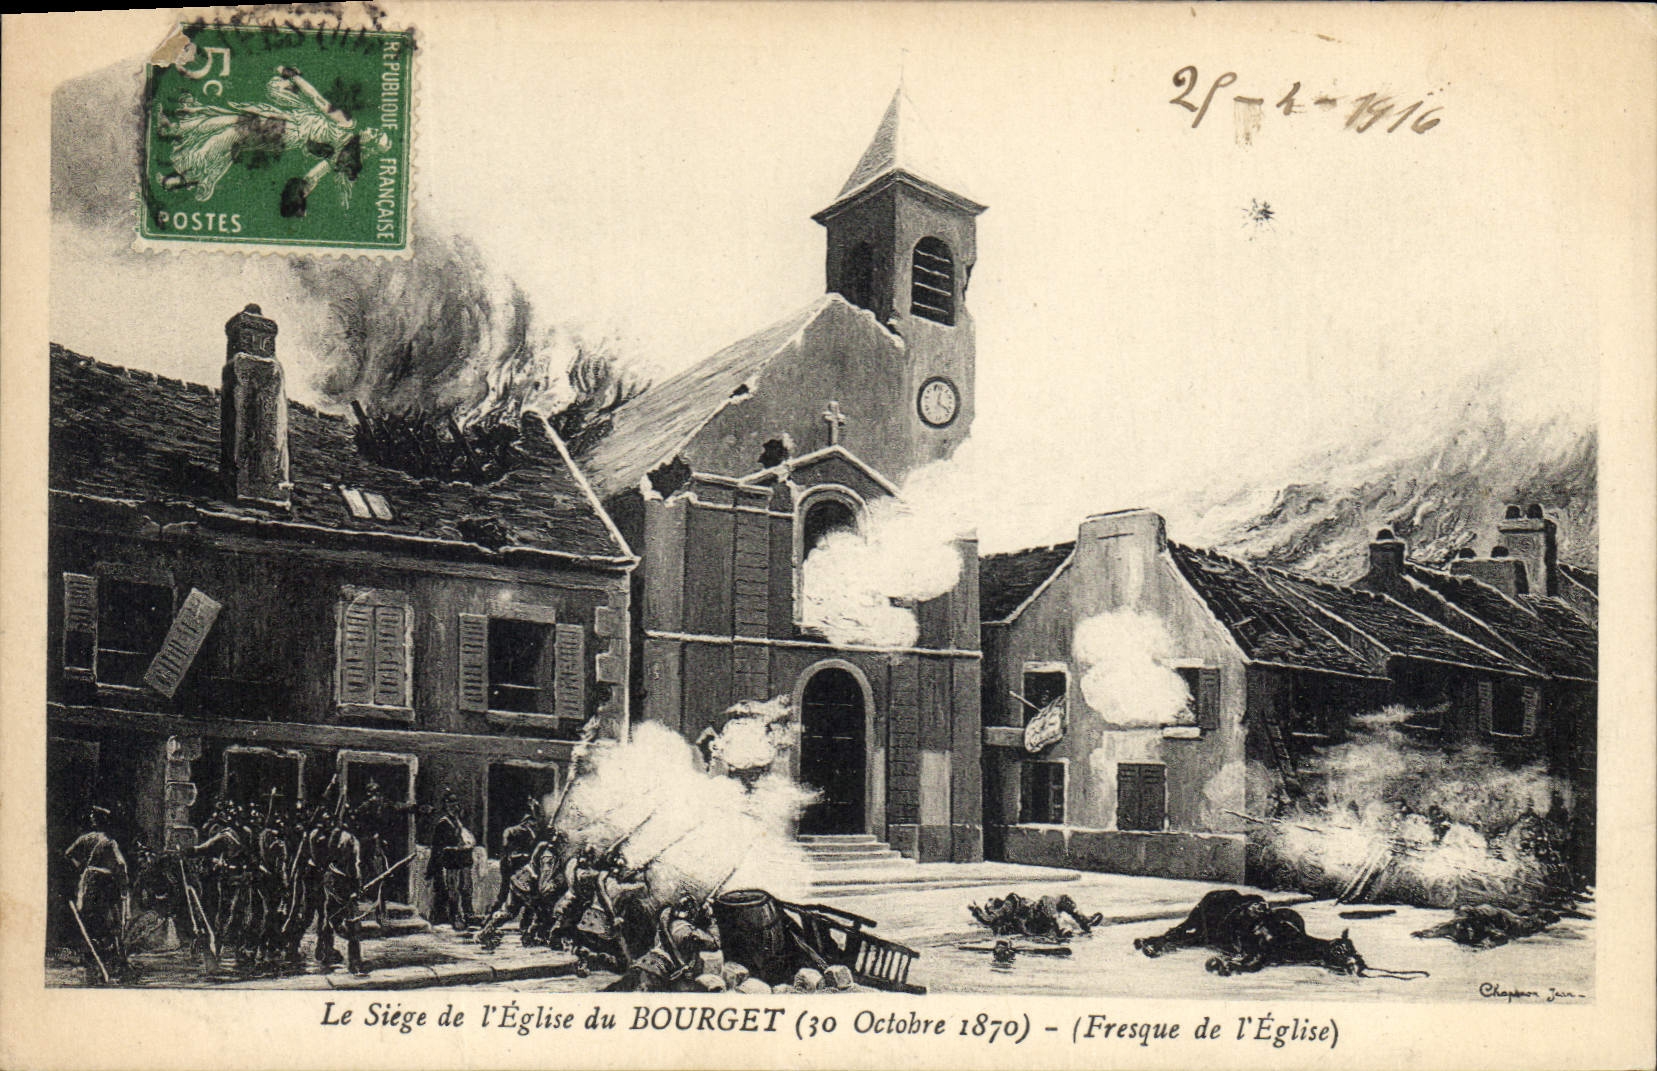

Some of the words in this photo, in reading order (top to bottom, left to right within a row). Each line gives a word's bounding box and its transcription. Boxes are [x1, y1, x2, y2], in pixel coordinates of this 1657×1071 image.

[158, 211, 242, 233] POSTES
[376, 157, 397, 240] FRANÇAISE
[321, 1002, 352, 1026] Le
[364, 1002, 427, 1034] Siège
[438, 1004, 465, 1028] de
[481, 1000, 574, 1036] l'Église
[584, 1006, 616, 1030] du
[629, 1006, 786, 1032] BOURGET
[795, 1010, 837, 1041] (30
[853, 1010, 946, 1035] Octobre
[959, 1013, 1031, 1045] 1870)
[1072, 1014, 1180, 1047] (Fresque
[1194, 1016, 1221, 1040] de
[1236, 1012, 1339, 1049] l'Église)
